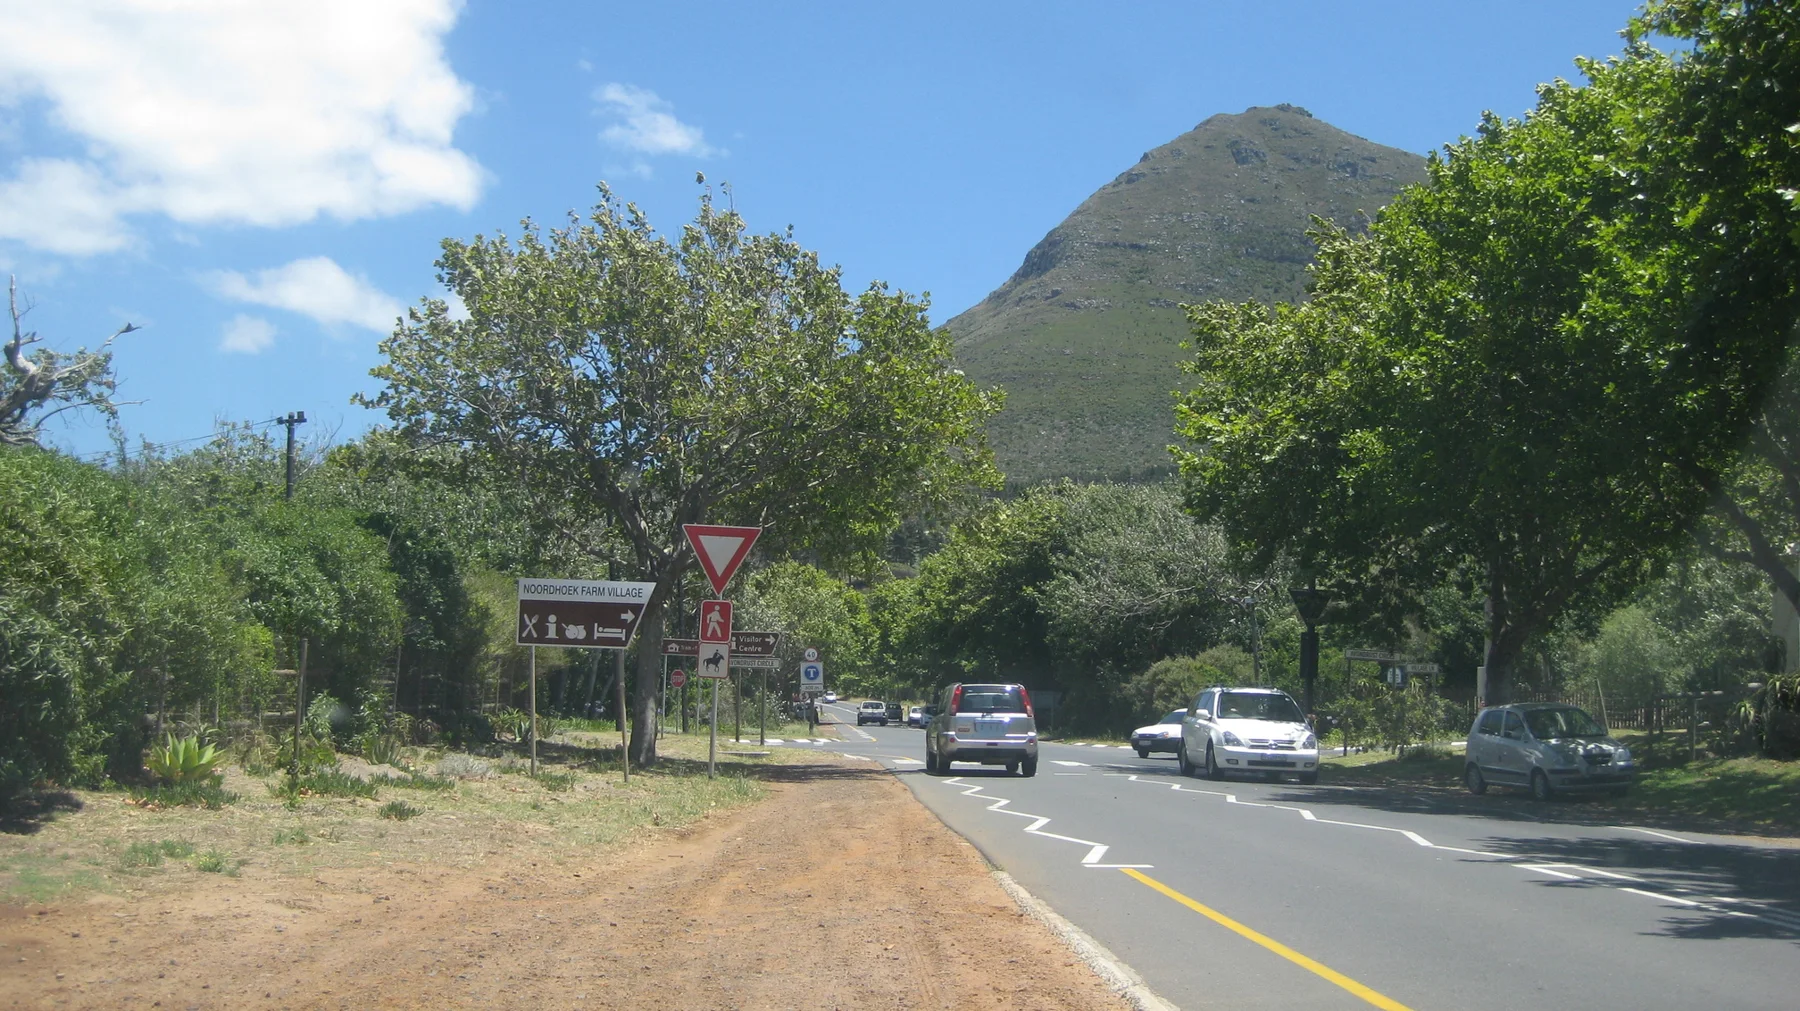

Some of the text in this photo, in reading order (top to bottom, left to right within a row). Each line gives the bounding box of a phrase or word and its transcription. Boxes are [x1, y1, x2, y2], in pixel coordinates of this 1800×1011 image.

[523, 584, 643, 598] NOORDHOEK FARM VILLAGE
[739, 635, 762, 643] Visitor
[730, 659, 756, 667] VONDRUST
[672, 675, 685, 683] STOP
